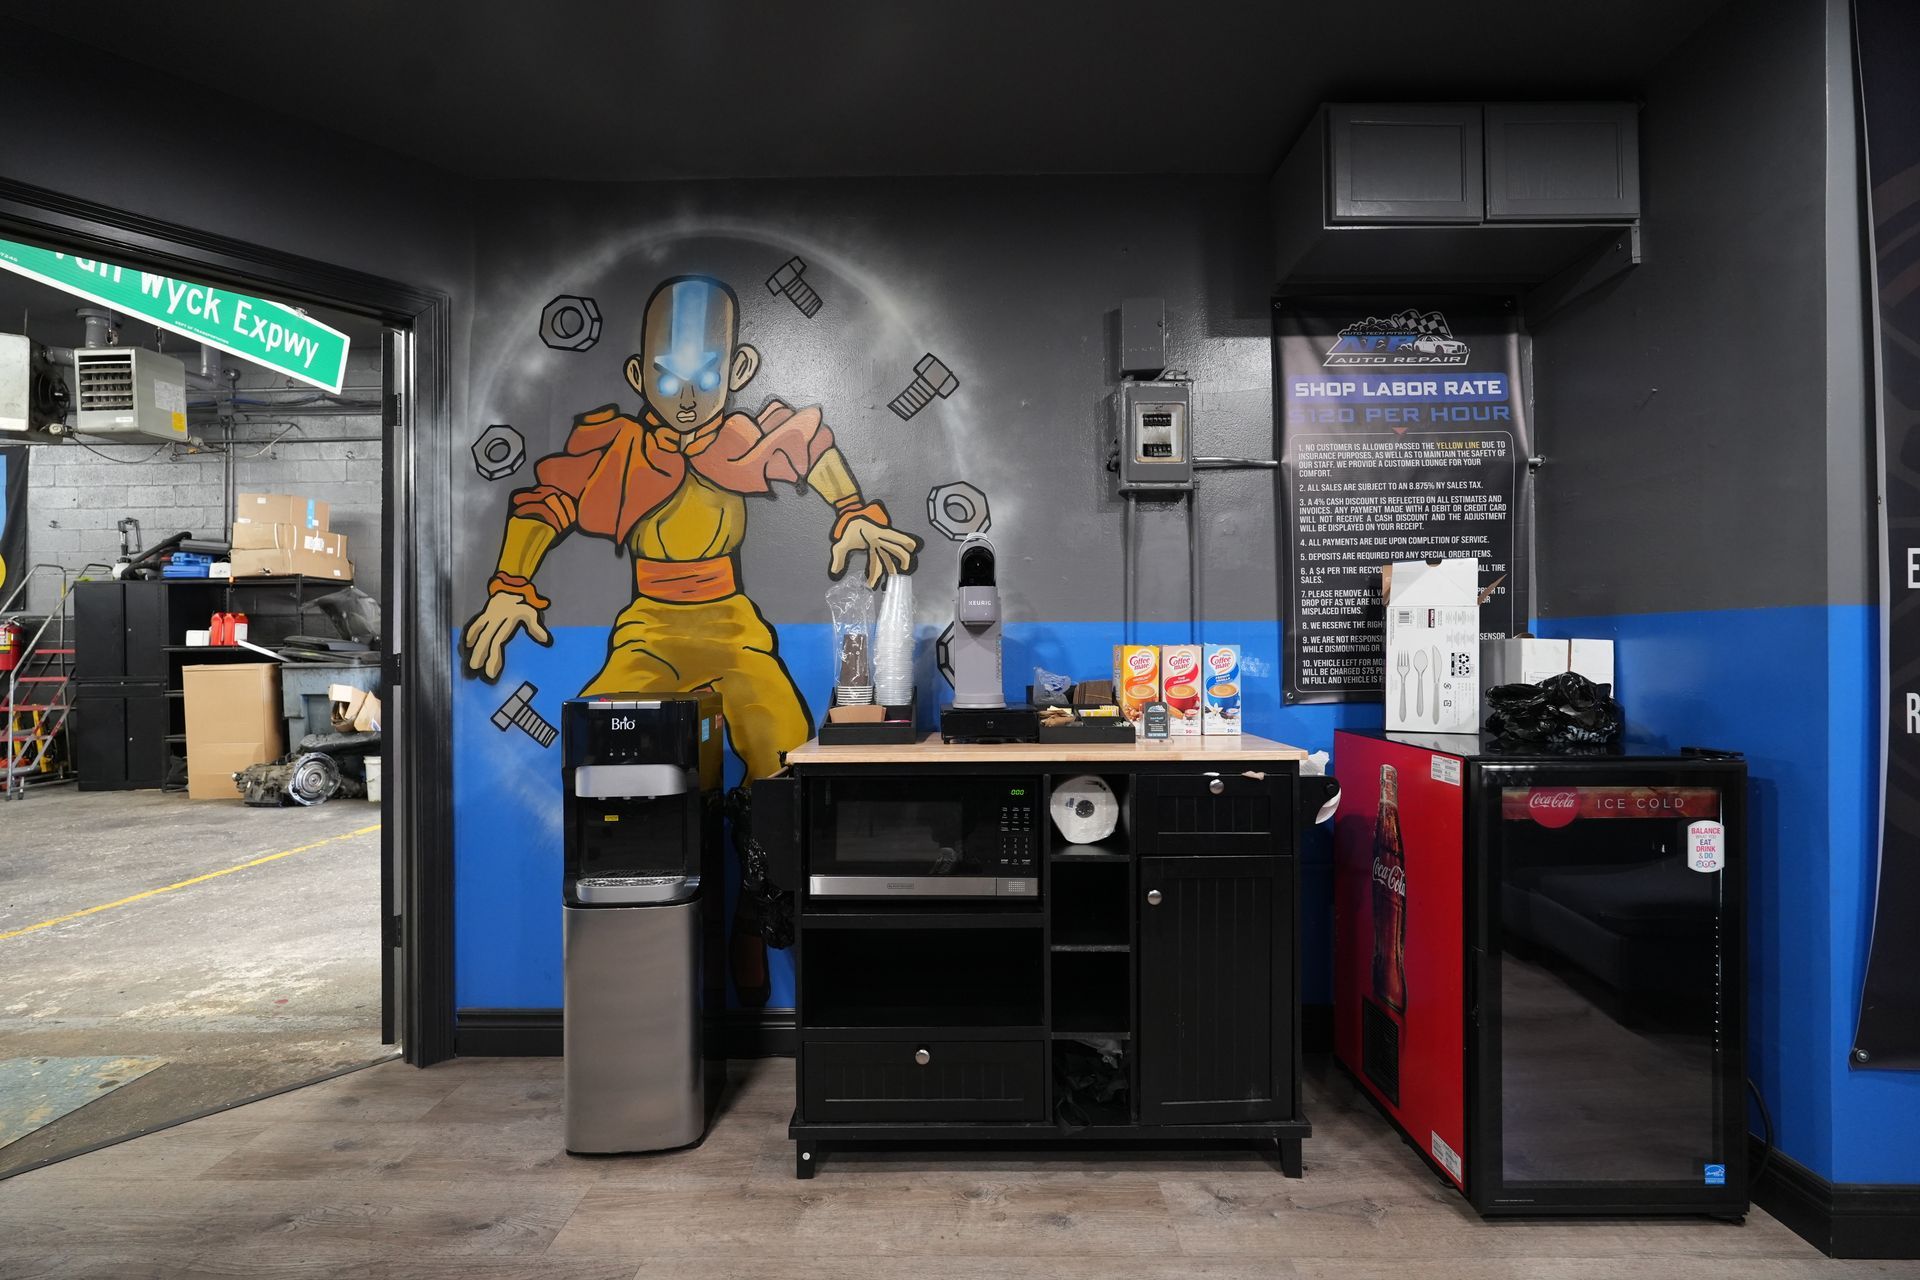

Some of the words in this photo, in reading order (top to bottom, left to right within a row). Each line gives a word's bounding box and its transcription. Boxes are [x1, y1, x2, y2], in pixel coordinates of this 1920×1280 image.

[233, 300, 319, 369] Expwy
[1295, 382, 1356, 397] SHOP
[1363, 382, 1438, 397] LABOR
[1444, 380, 1502, 395] RATE
[1366, 407, 1420, 422] PER
[1431, 406, 1512, 422] HOUR
[1309, 553, 1341, 561] DEPOSITS
[1357, 552, 1389, 560] REQUIRED
[1130, 656, 1150, 666] Coffee
[1169, 656, 1190, 666] Coffee
[1210, 655, 1231, 665] Coffee
[611, 716, 634, 730] Brio
[1597, 799, 1626, 809] ICE
[1636, 798, 1685, 809] COLD
